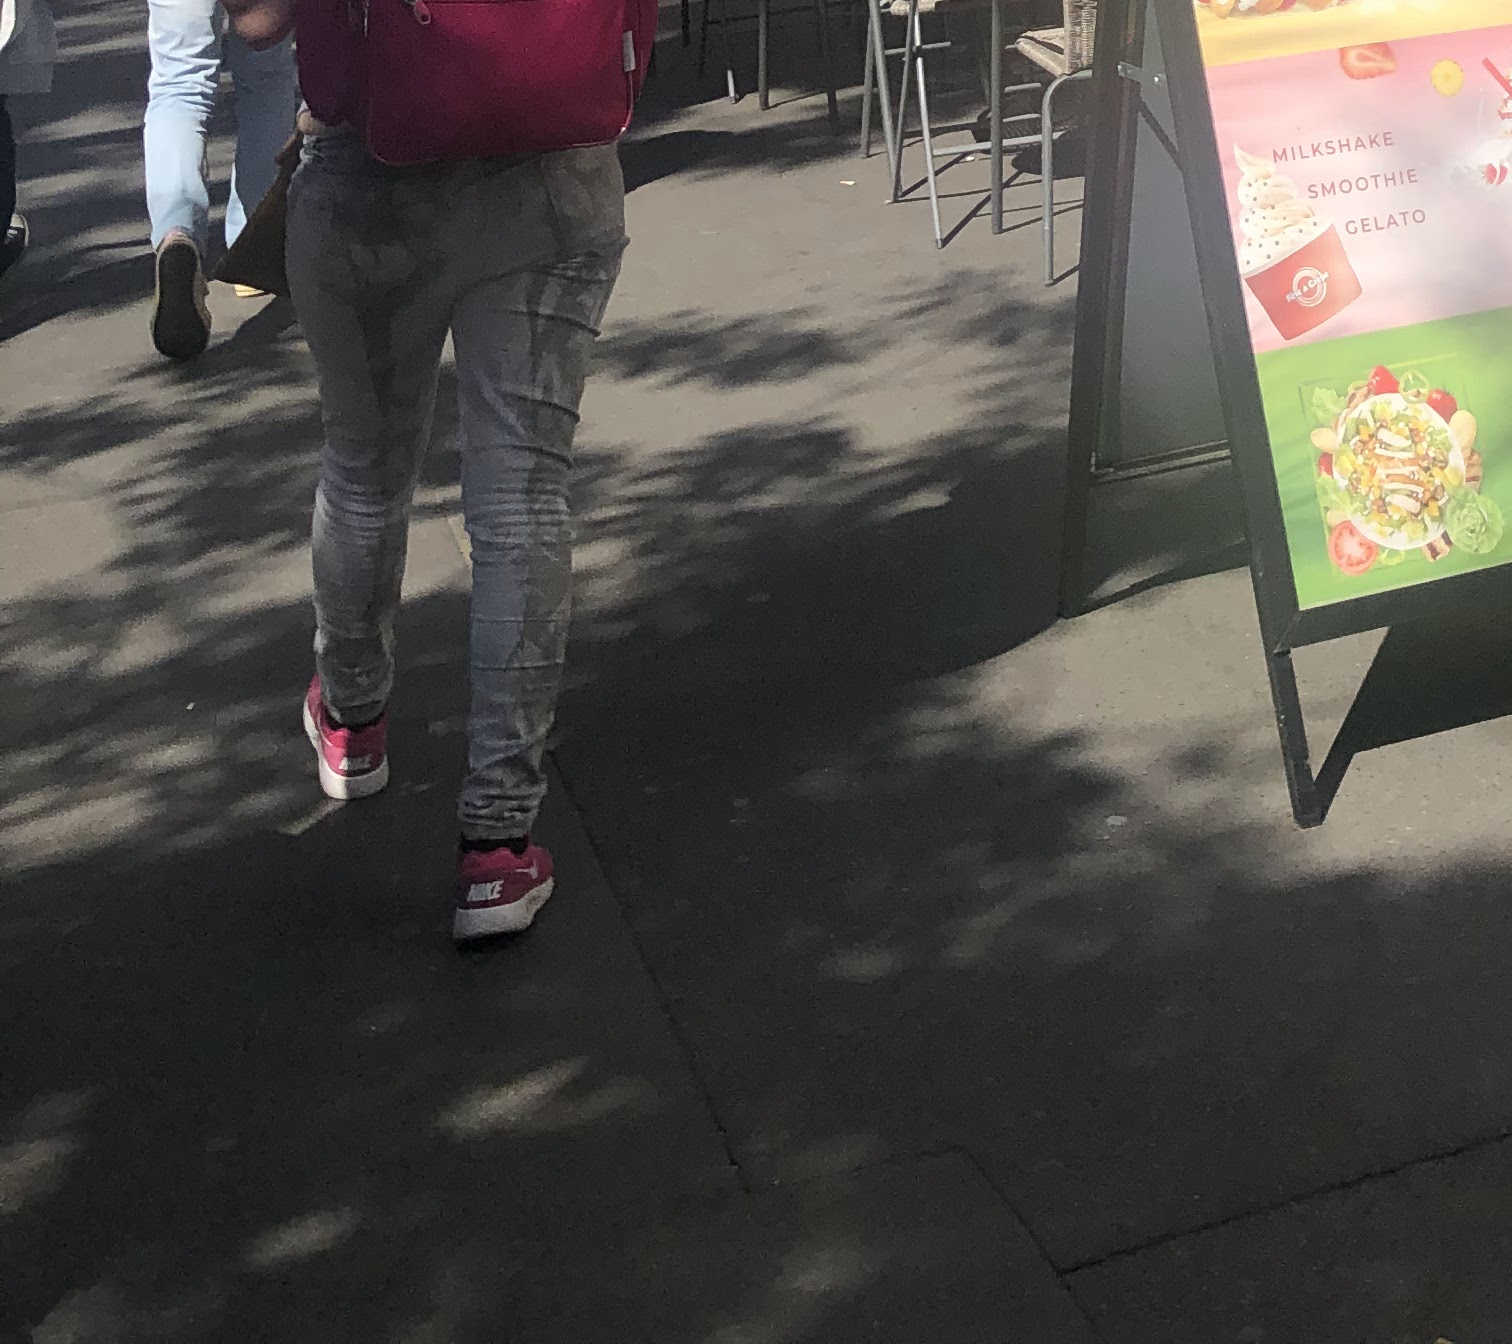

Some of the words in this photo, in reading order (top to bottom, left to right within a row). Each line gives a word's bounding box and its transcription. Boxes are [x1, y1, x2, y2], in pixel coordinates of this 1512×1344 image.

[1272, 132, 1394, 163] MILKSHAKE
[1308, 169, 1418, 199] SMOOTHIE
[1345, 209, 1427, 236] GELATO
[467, 880, 504, 900] NIKE
